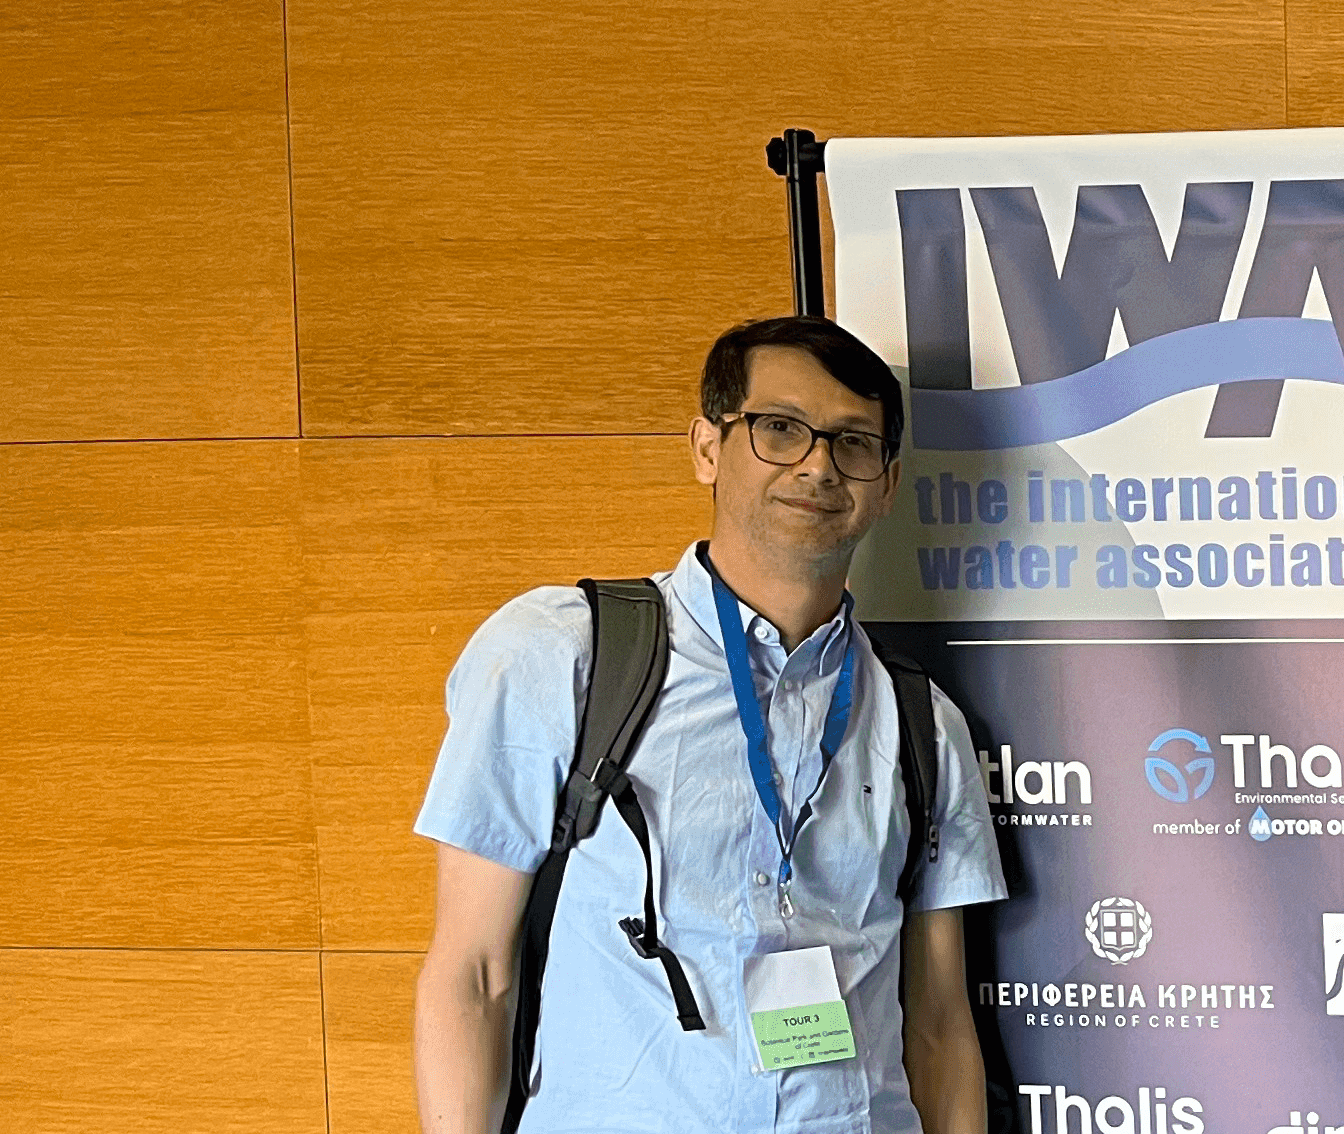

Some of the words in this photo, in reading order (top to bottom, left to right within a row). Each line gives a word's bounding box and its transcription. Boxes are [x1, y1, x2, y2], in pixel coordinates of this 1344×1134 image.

[915, 474, 1010, 526] the
[917, 536, 1077, 591] water
[979, 744, 1092, 804] tlan
[1235, 793, 1326, 803] Environmental
[992, 814, 1093, 826] ORMWATER
[1153, 819, 1220, 834] member
[1225, 819, 1241, 834] of
[1251, 819, 1323, 836] MOTOR
[980, 983, 1147, 1008] ΠΕΡΙΦΕΡΕΙΑ
[1159, 985, 1274, 1008] ΚΡΗΤΗΣ
[783, 1016, 812, 1027] TOUR
[1027, 1014, 1106, 1026] REGION
[1115, 1015, 1139, 1027] OF
[1149, 1016, 1219, 1028] CRETE
